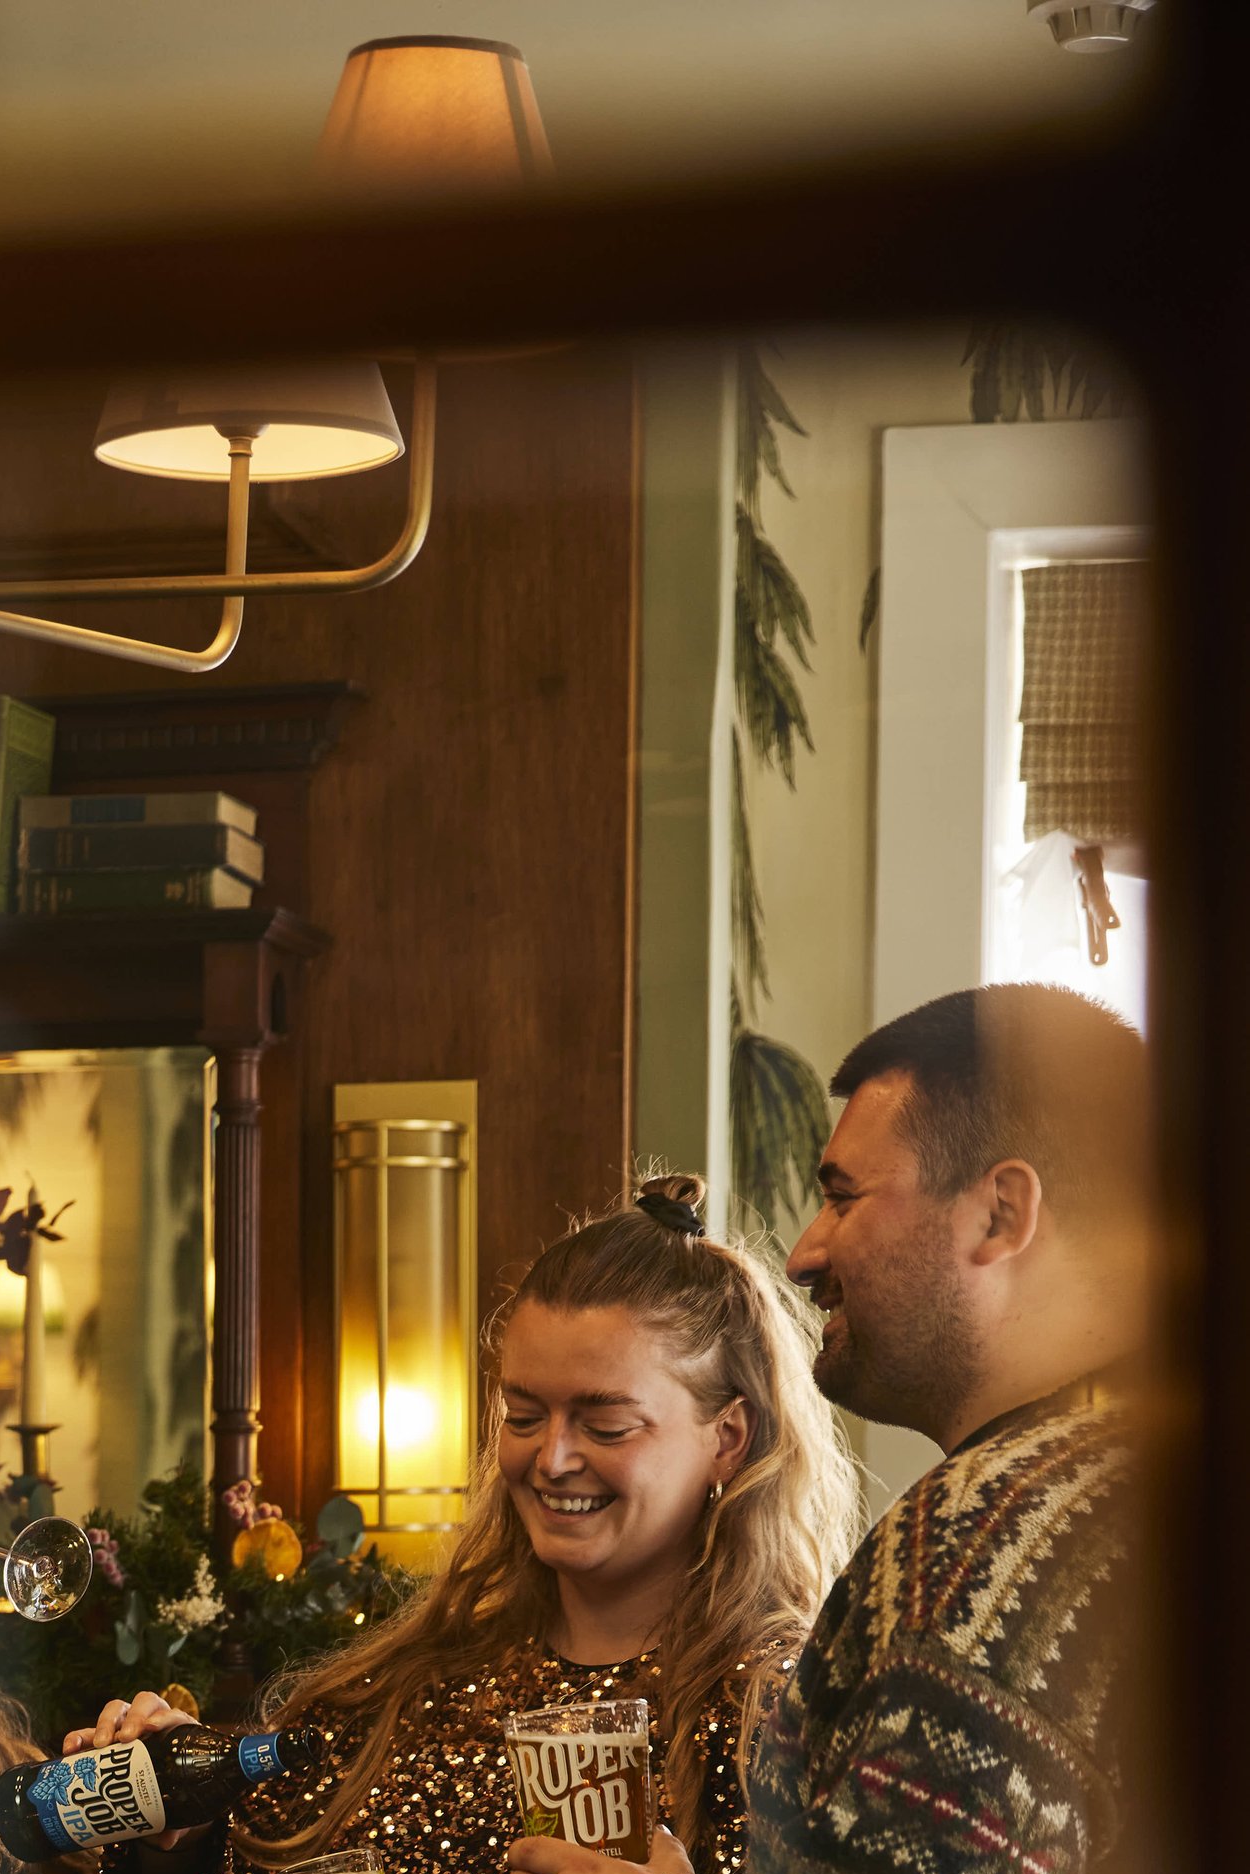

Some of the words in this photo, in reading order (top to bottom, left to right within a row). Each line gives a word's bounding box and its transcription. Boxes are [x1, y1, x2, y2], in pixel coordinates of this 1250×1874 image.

[244, 1747, 263, 1773] IPA
[257, 1744, 275, 1772] 0.5%
[99, 1746, 154, 1834] PROPER
[139, 1778, 152, 1807] AUSTELL
[62, 1809, 95, 1843] IPA
[71, 1787, 127, 1835] JOB
